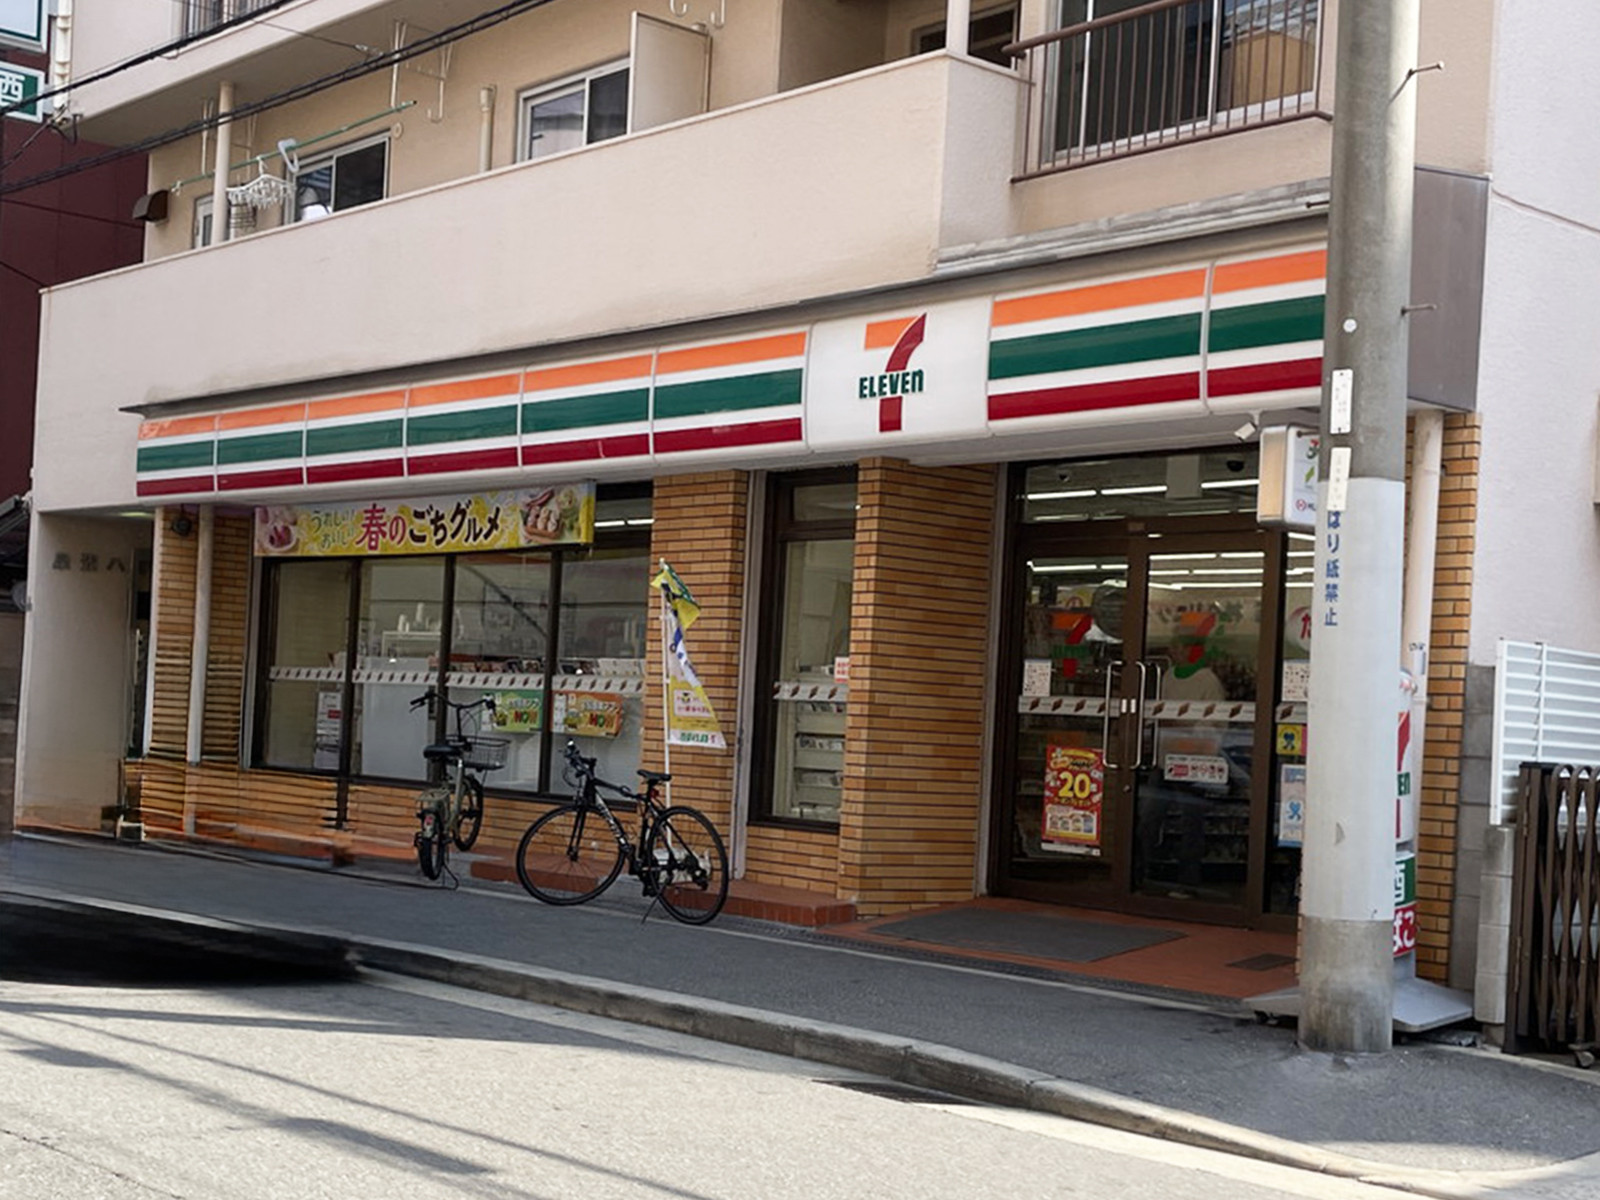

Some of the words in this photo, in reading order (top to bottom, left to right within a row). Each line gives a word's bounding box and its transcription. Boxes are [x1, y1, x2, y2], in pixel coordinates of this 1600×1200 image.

[864, 312, 927, 432] 7
[355, 499, 501, 551] 春のごちグルメ
[1059, 771, 1091, 798] 20
